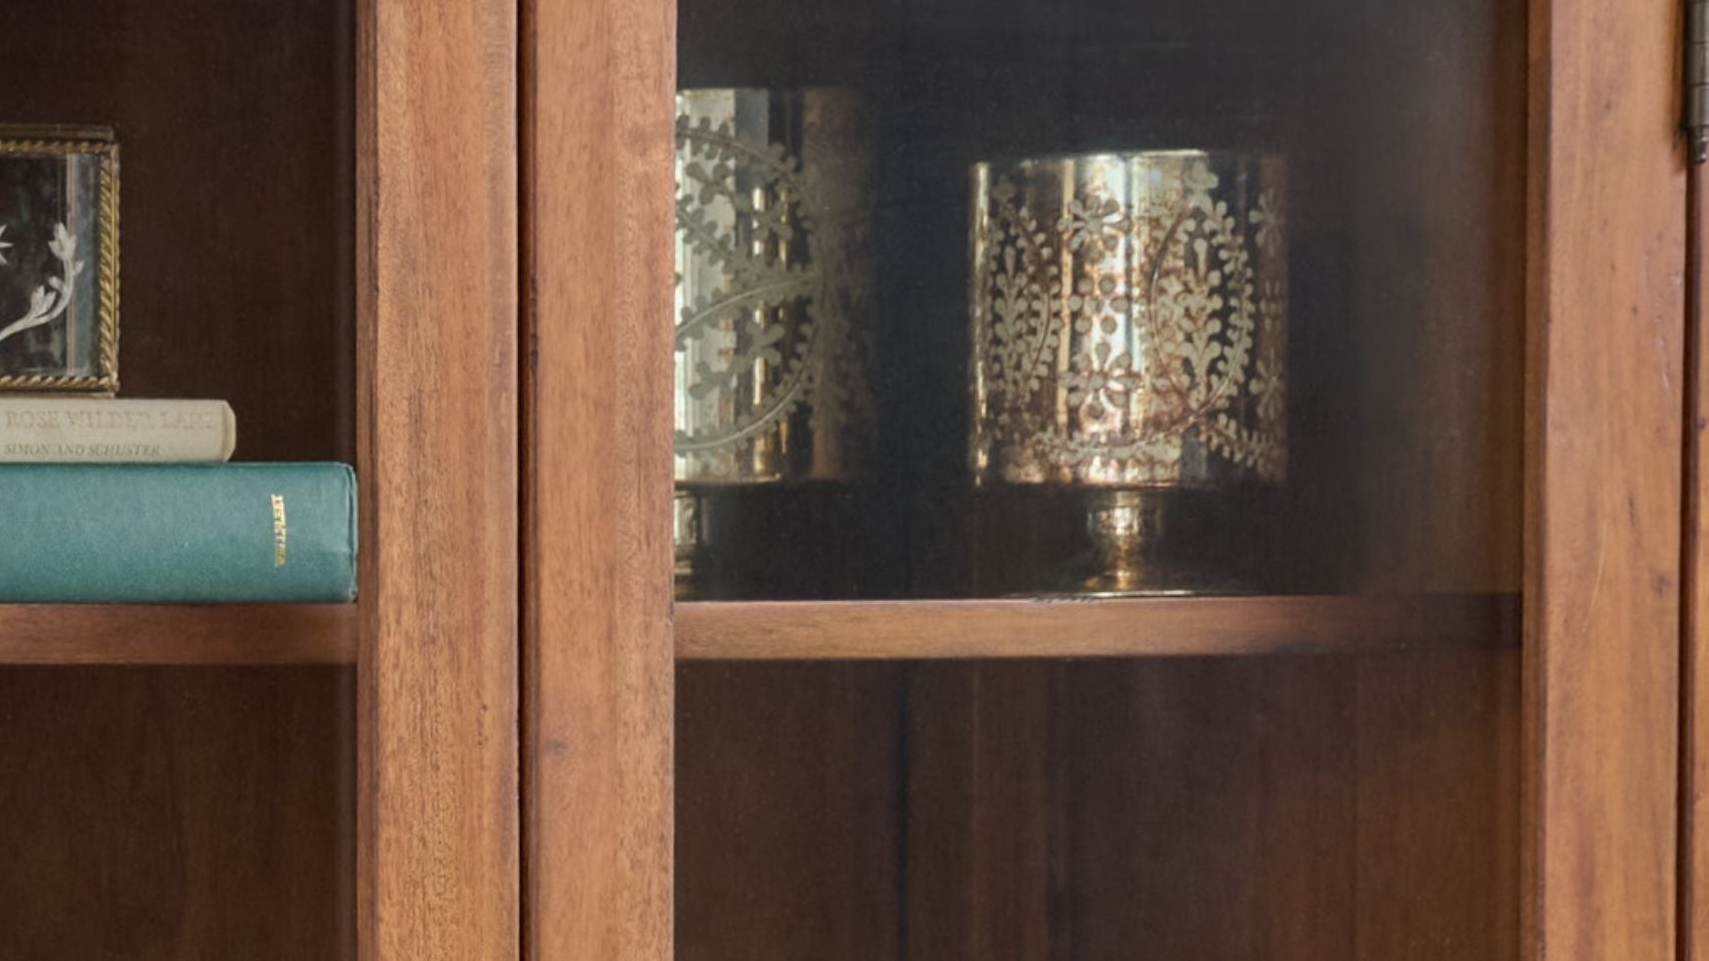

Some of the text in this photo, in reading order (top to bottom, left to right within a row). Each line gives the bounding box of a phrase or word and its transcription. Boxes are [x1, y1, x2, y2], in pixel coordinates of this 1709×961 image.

[4, 410, 60, 429] ROSE
[4, 442, 162, 457] SIMON AND SCHUSTER
